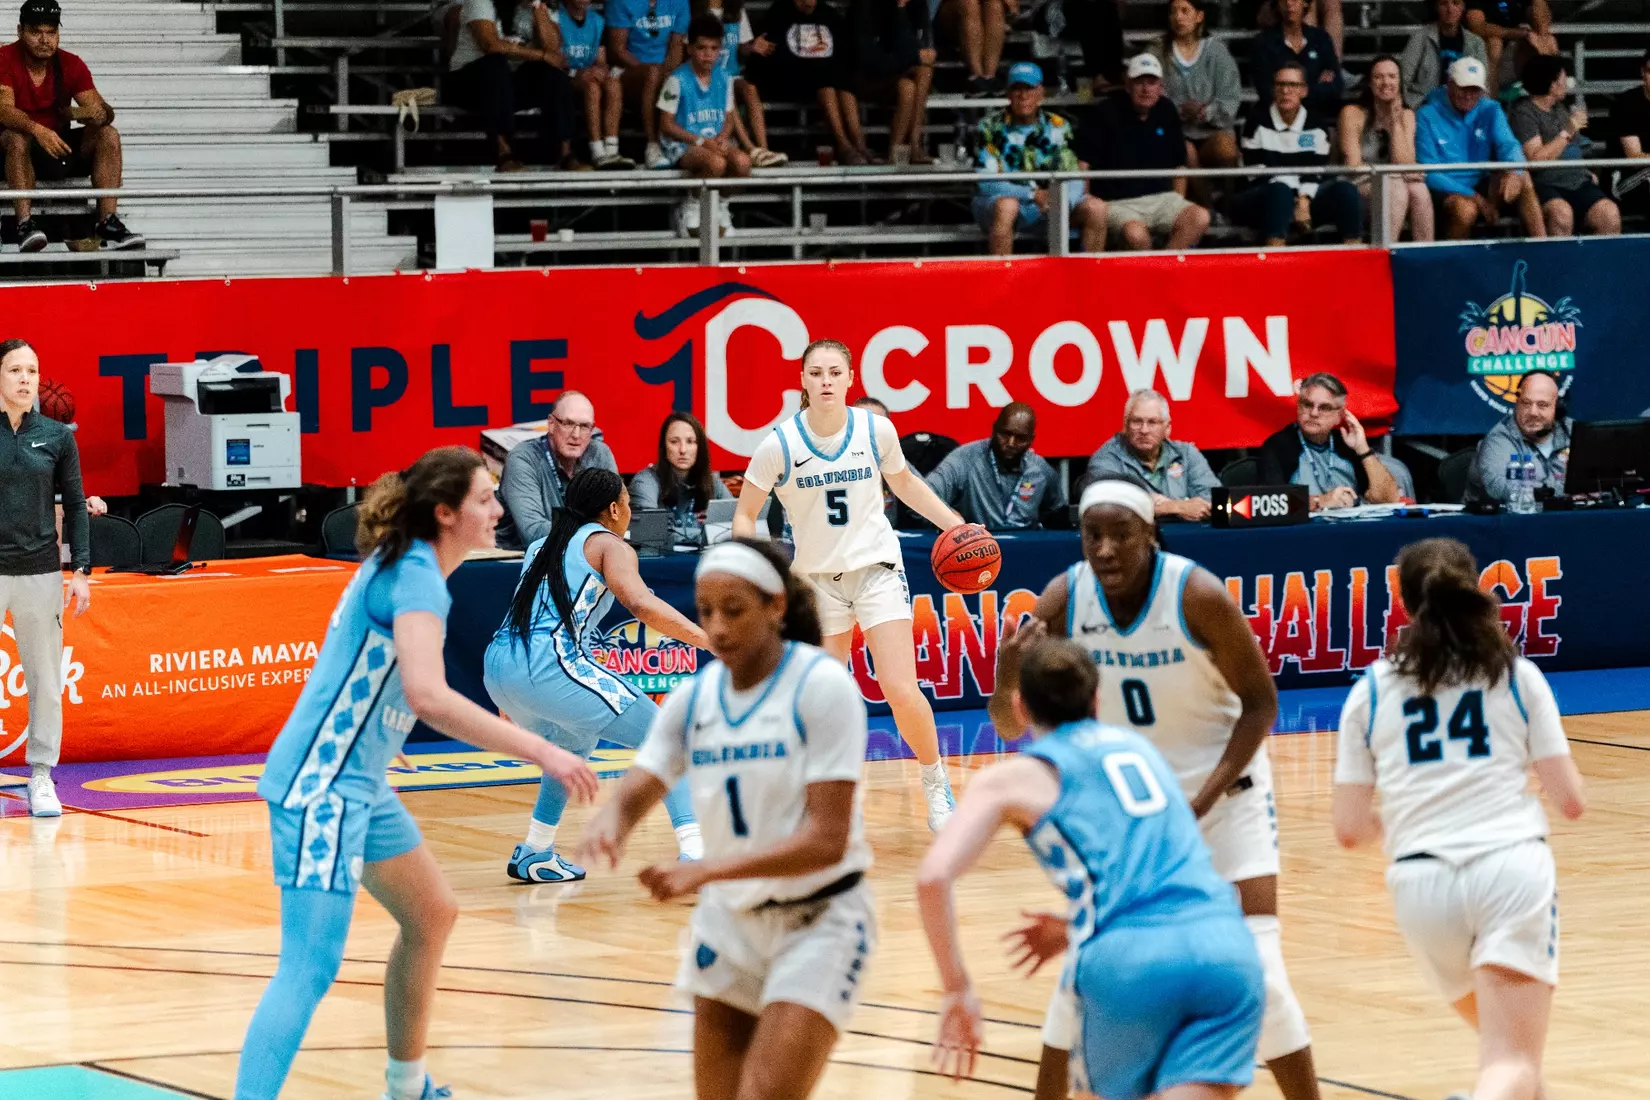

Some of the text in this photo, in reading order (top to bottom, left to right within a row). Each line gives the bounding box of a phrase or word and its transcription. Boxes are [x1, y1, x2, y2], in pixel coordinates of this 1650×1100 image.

[860, 315, 1295, 413] CROWN
[1472, 355, 1569, 372] CHALLENGE
[796, 467, 872, 488] COLUMBIA
[825, 488, 849, 527] 5
[1251, 494, 1288, 517] POSS
[955, 543, 999, 563] Wilson
[150, 641, 321, 674] RIVIERA MAYA
[101, 684, 127, 699] AN
[132, 674, 256, 697] ALL-INCLUSIVE
[1121, 678, 1156, 726] 0
[1402, 690, 1491, 765] 24
[1102, 752, 1168, 817] 0
[725, 774, 749, 837] 1
